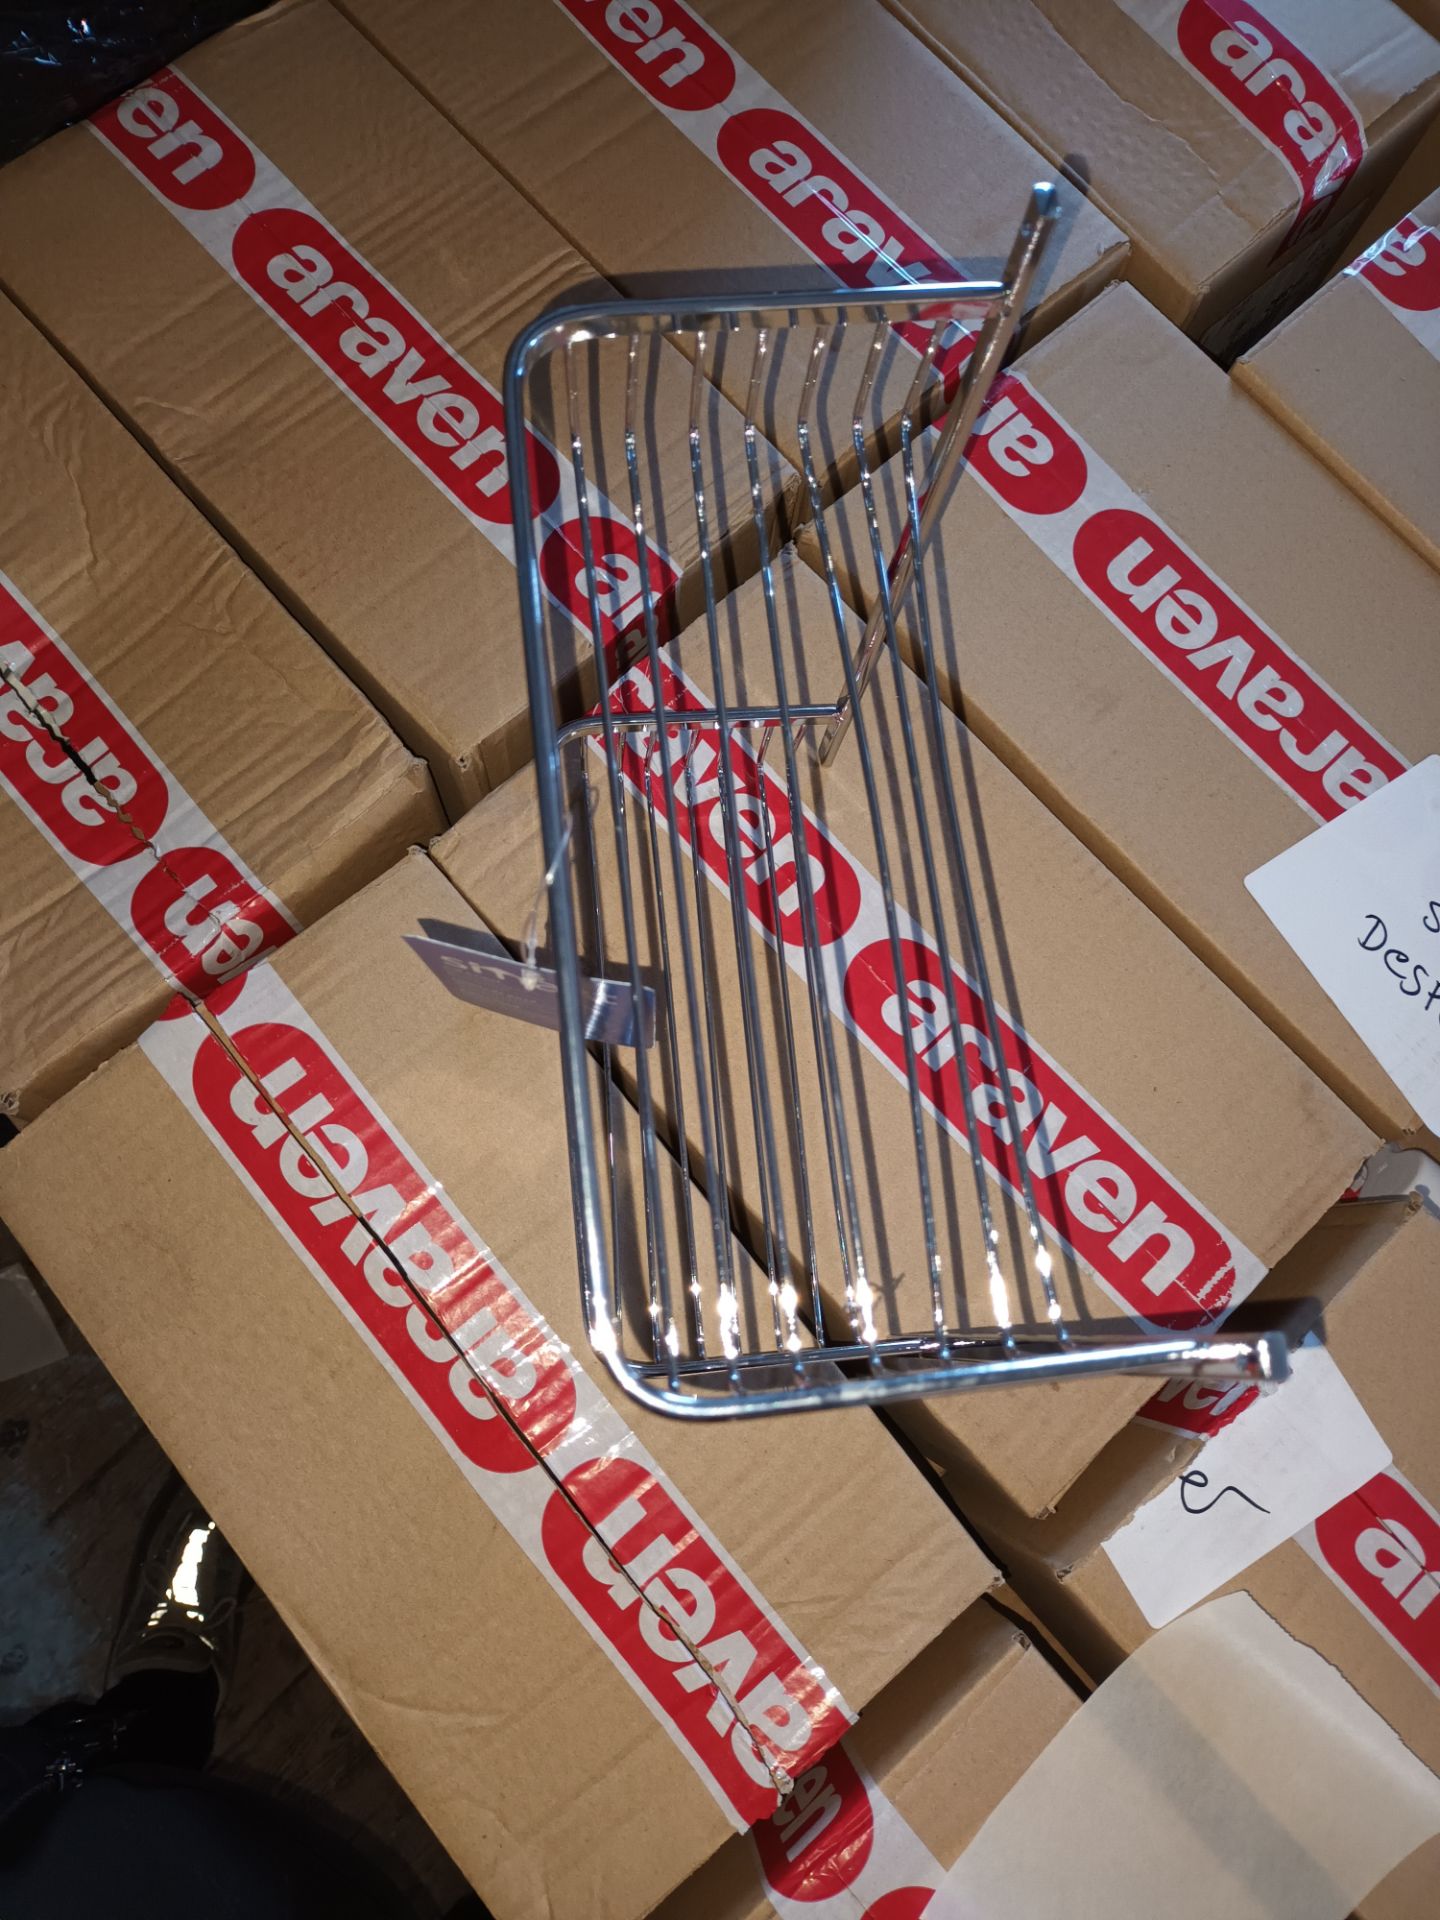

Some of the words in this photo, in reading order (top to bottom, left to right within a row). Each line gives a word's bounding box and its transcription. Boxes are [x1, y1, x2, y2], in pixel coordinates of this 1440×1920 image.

[116, 87, 224, 185] en
[1106, 536, 1390, 811] araven
[230, 1057, 537, 1421] araven
[881, 979, 1195, 1297] araven
